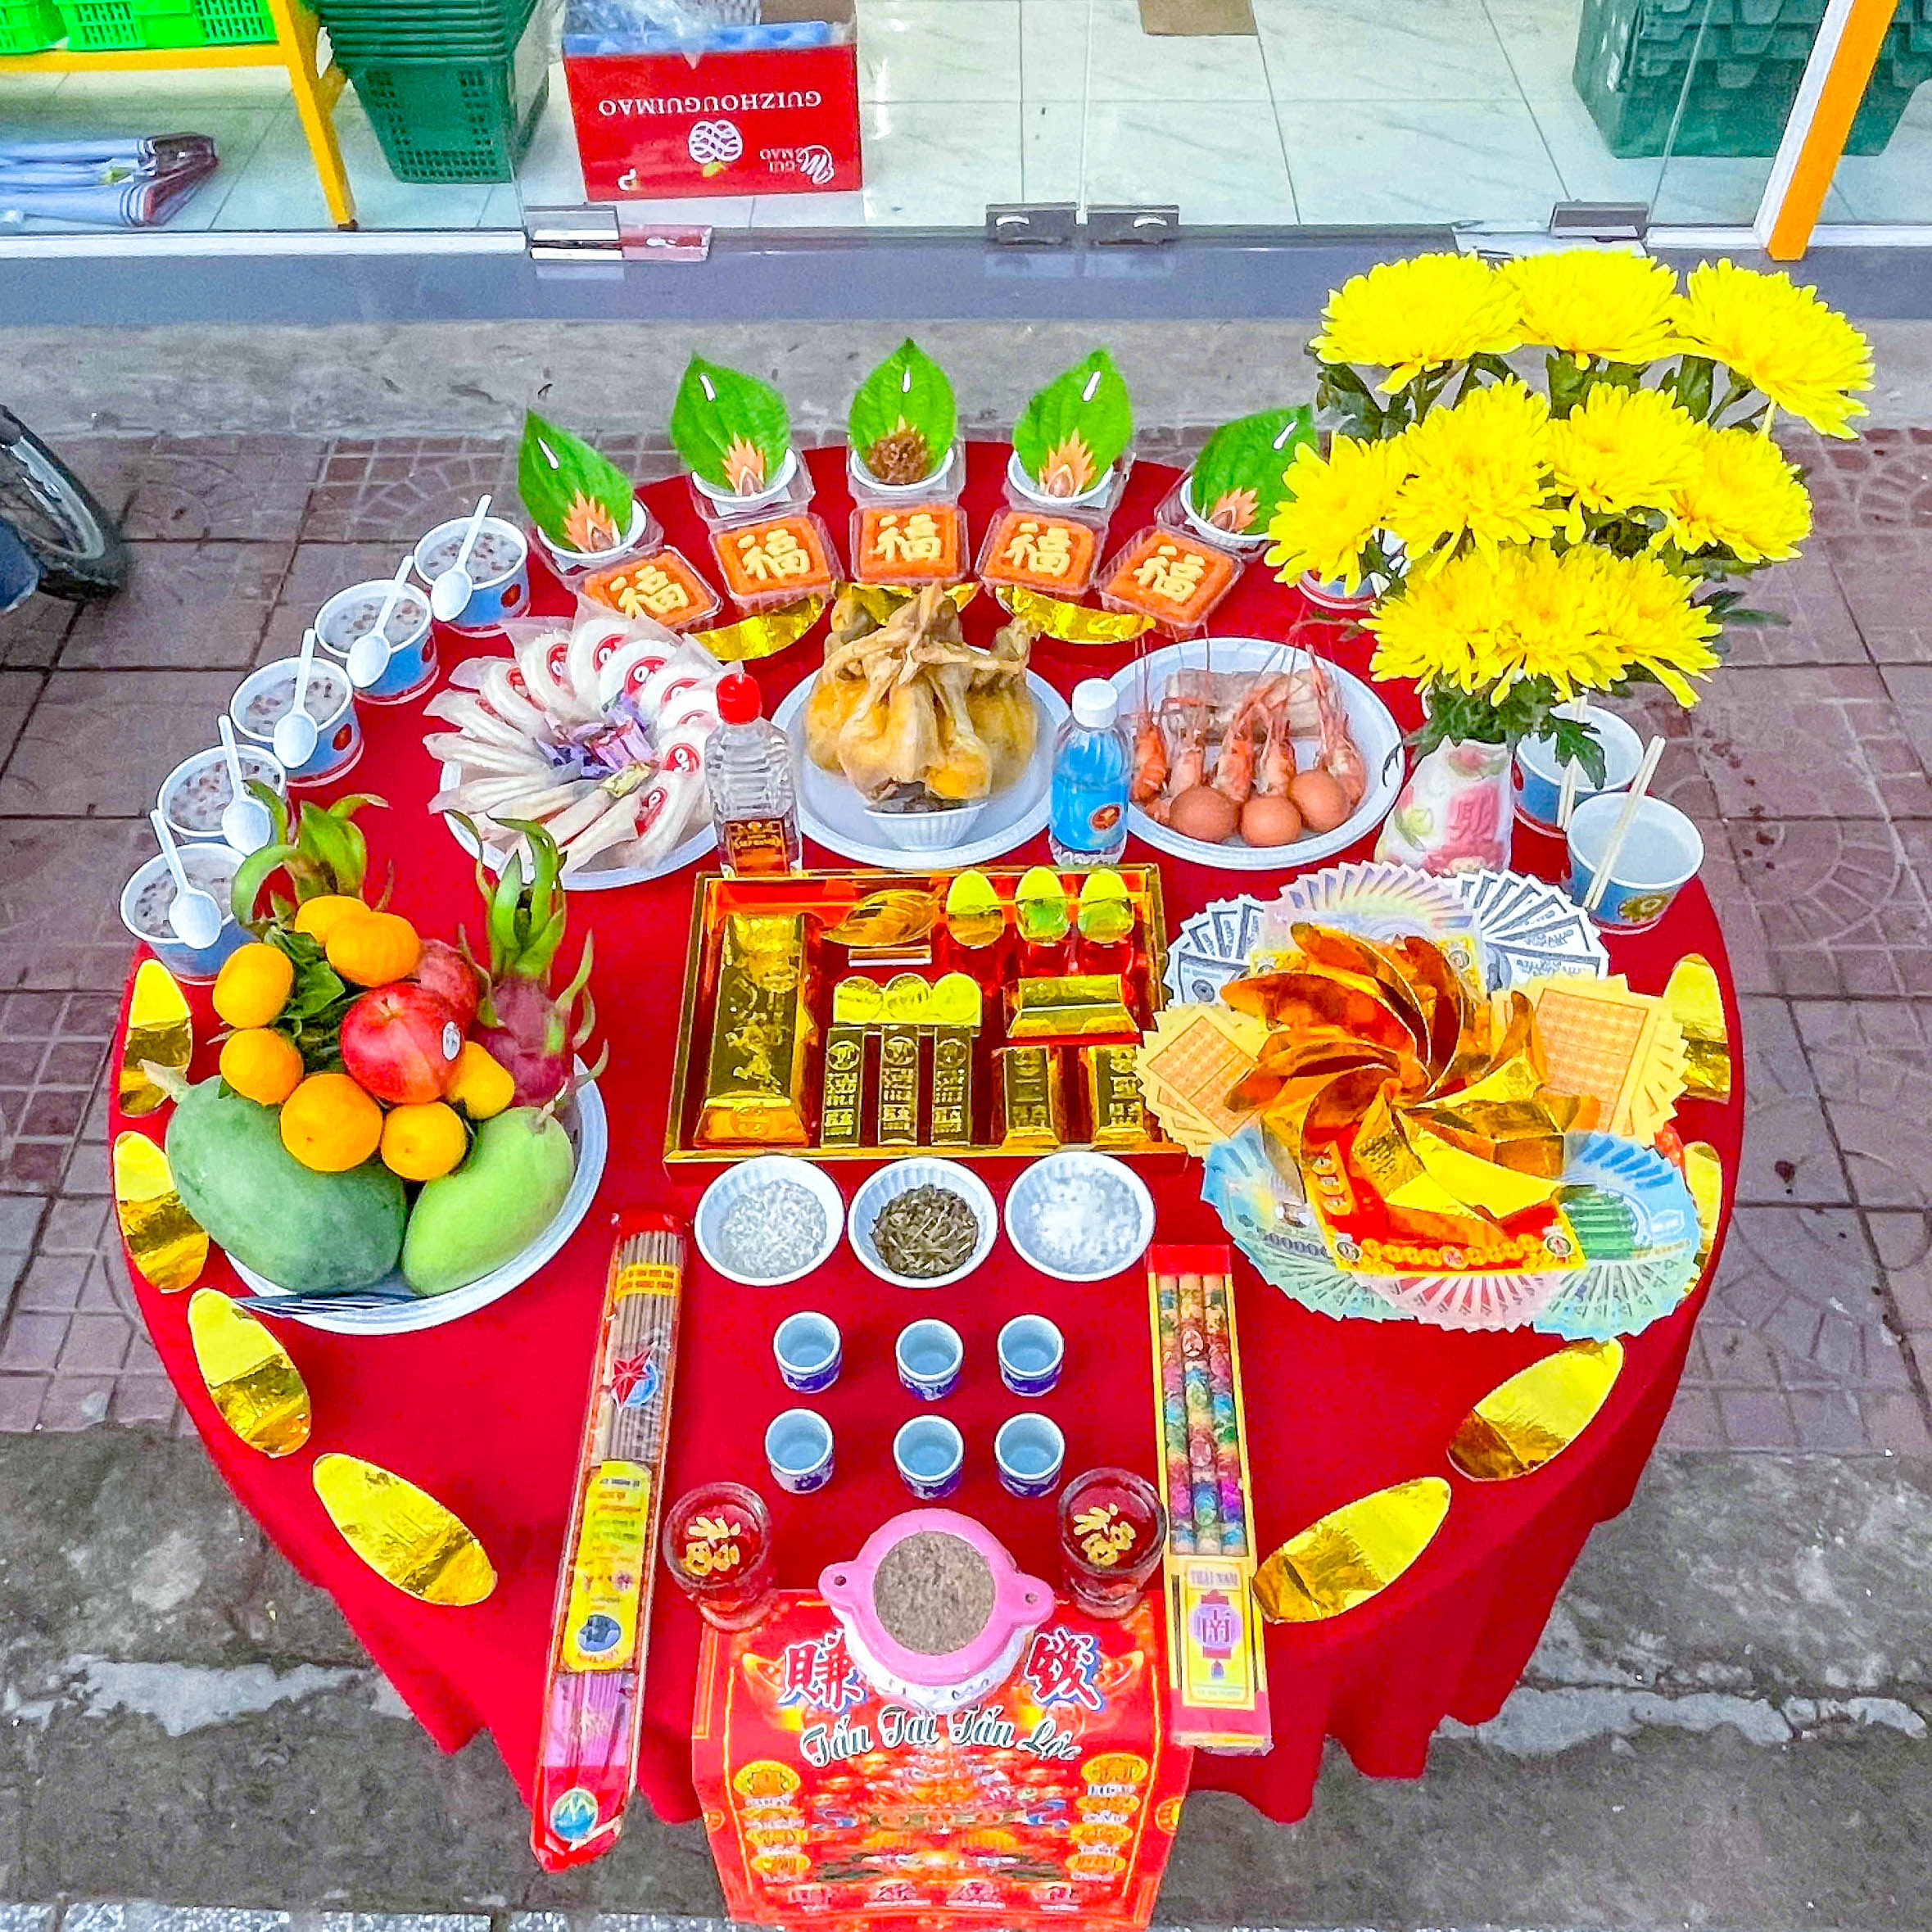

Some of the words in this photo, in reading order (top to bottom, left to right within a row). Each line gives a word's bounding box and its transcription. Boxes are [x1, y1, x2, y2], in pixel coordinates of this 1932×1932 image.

[598, 91, 822, 117] GUIZHOUGUIMAO
[759, 148, 794, 160] MAO
[768, 161, 795, 173] GUI
[736, 527, 811, 581] 福
[869, 513, 942, 562] 福
[1003, 522, 1073, 577] 福
[609, 564, 690, 620] 福
[1133, 545, 1206, 603] 福
[799, 1713, 875, 1768] Tấn
[947, 1704, 1016, 1749] Tấn
